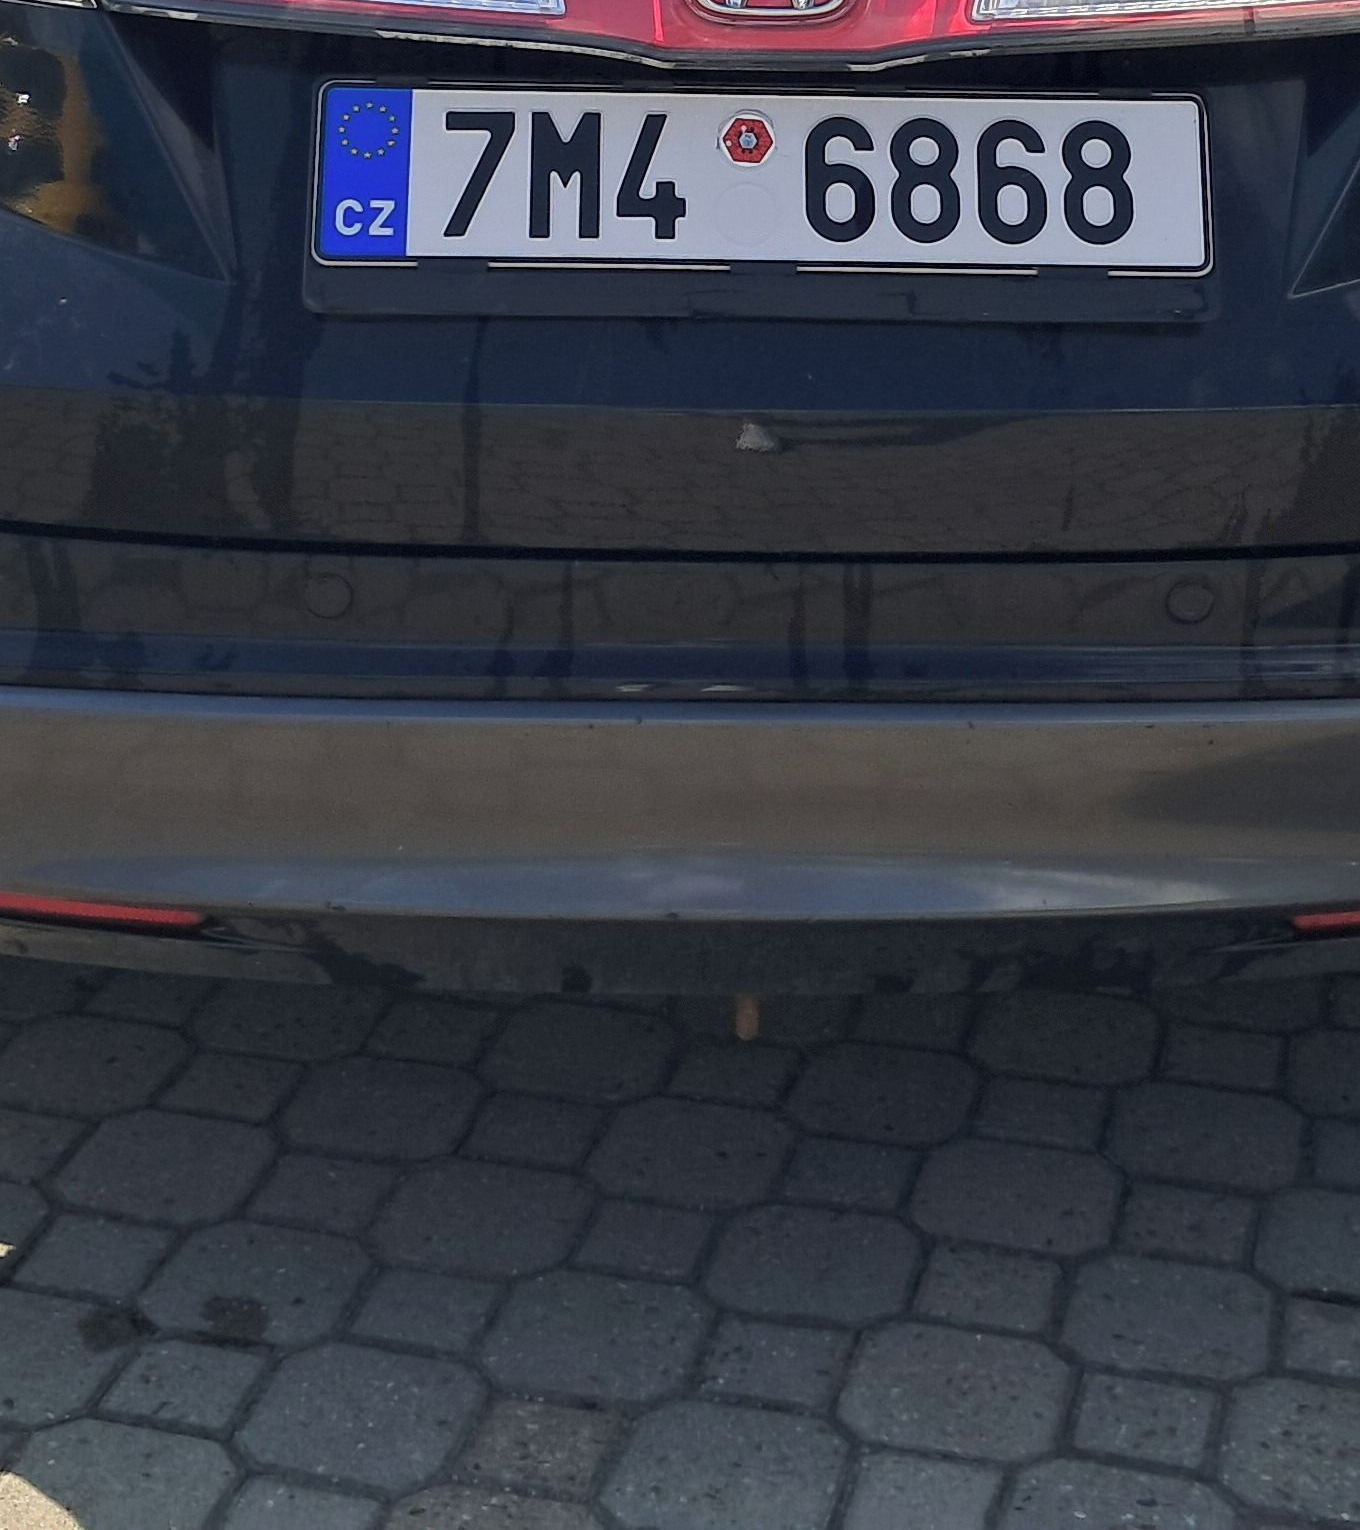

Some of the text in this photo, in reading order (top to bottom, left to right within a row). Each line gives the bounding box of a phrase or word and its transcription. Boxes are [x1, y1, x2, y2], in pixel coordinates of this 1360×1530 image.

[335, 197, 396, 237] CZ
[442, 111, 1135, 245] 7M4 6868
